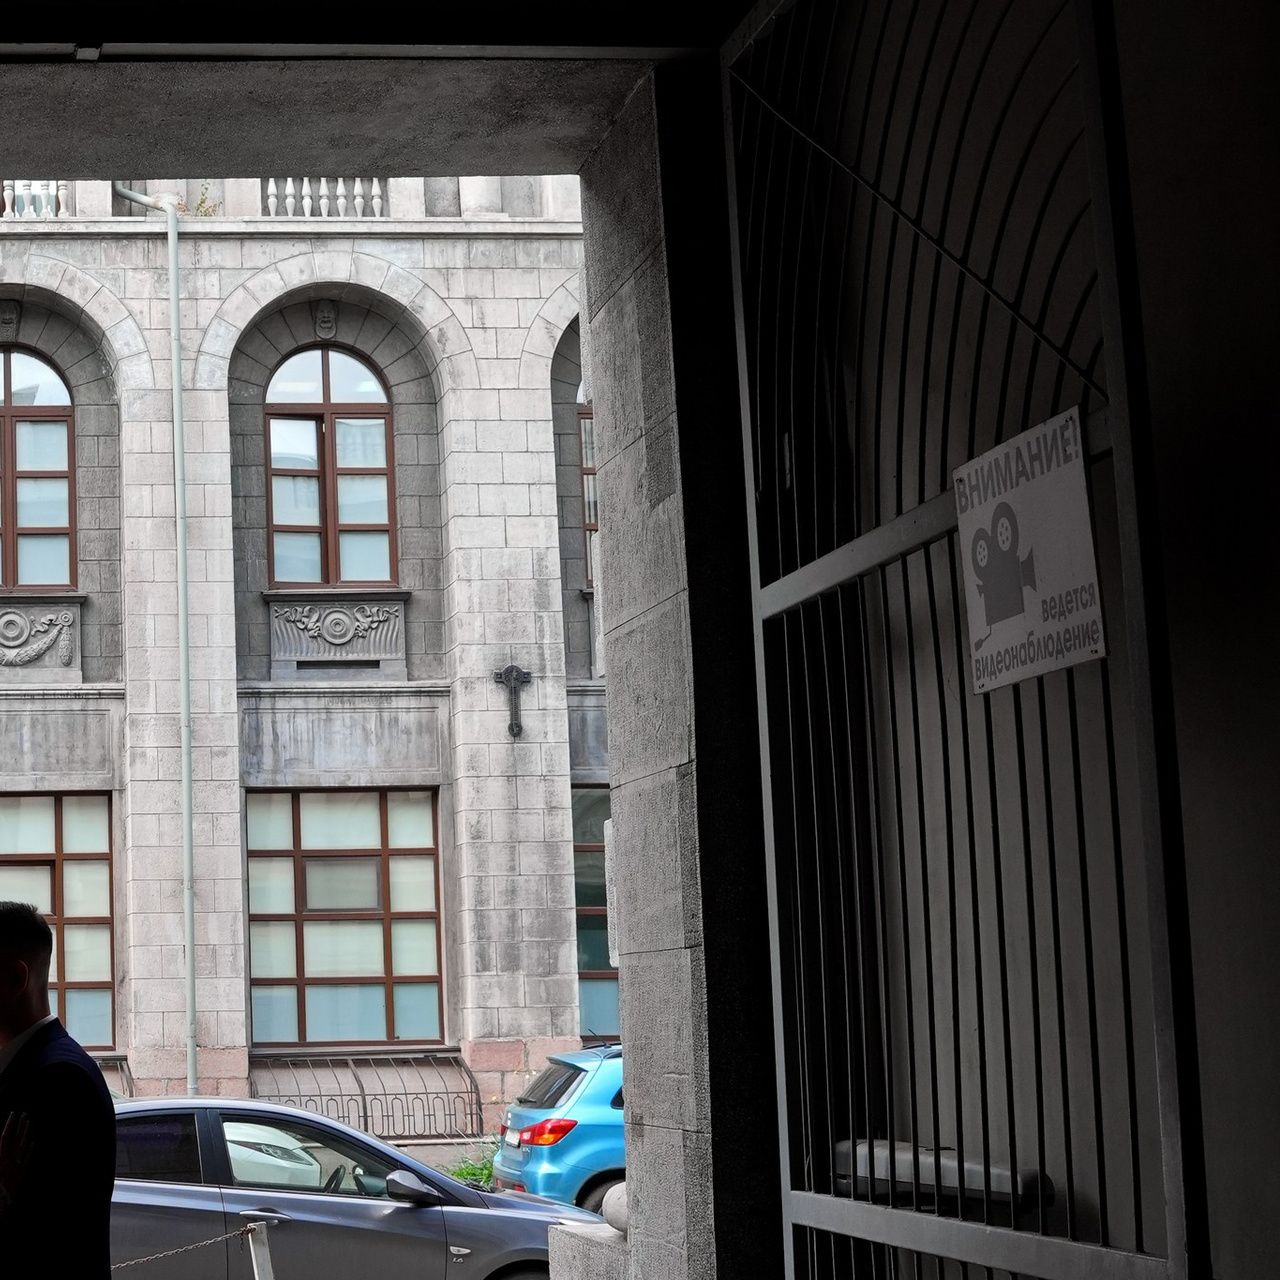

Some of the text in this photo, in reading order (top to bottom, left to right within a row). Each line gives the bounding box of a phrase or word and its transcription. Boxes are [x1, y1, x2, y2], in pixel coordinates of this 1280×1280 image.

[956, 419, 1080, 515] ВНИМАНИЕ!
[1041, 581, 1096, 624] ведется
[974, 619, 1101, 681] видеонаблюдение
